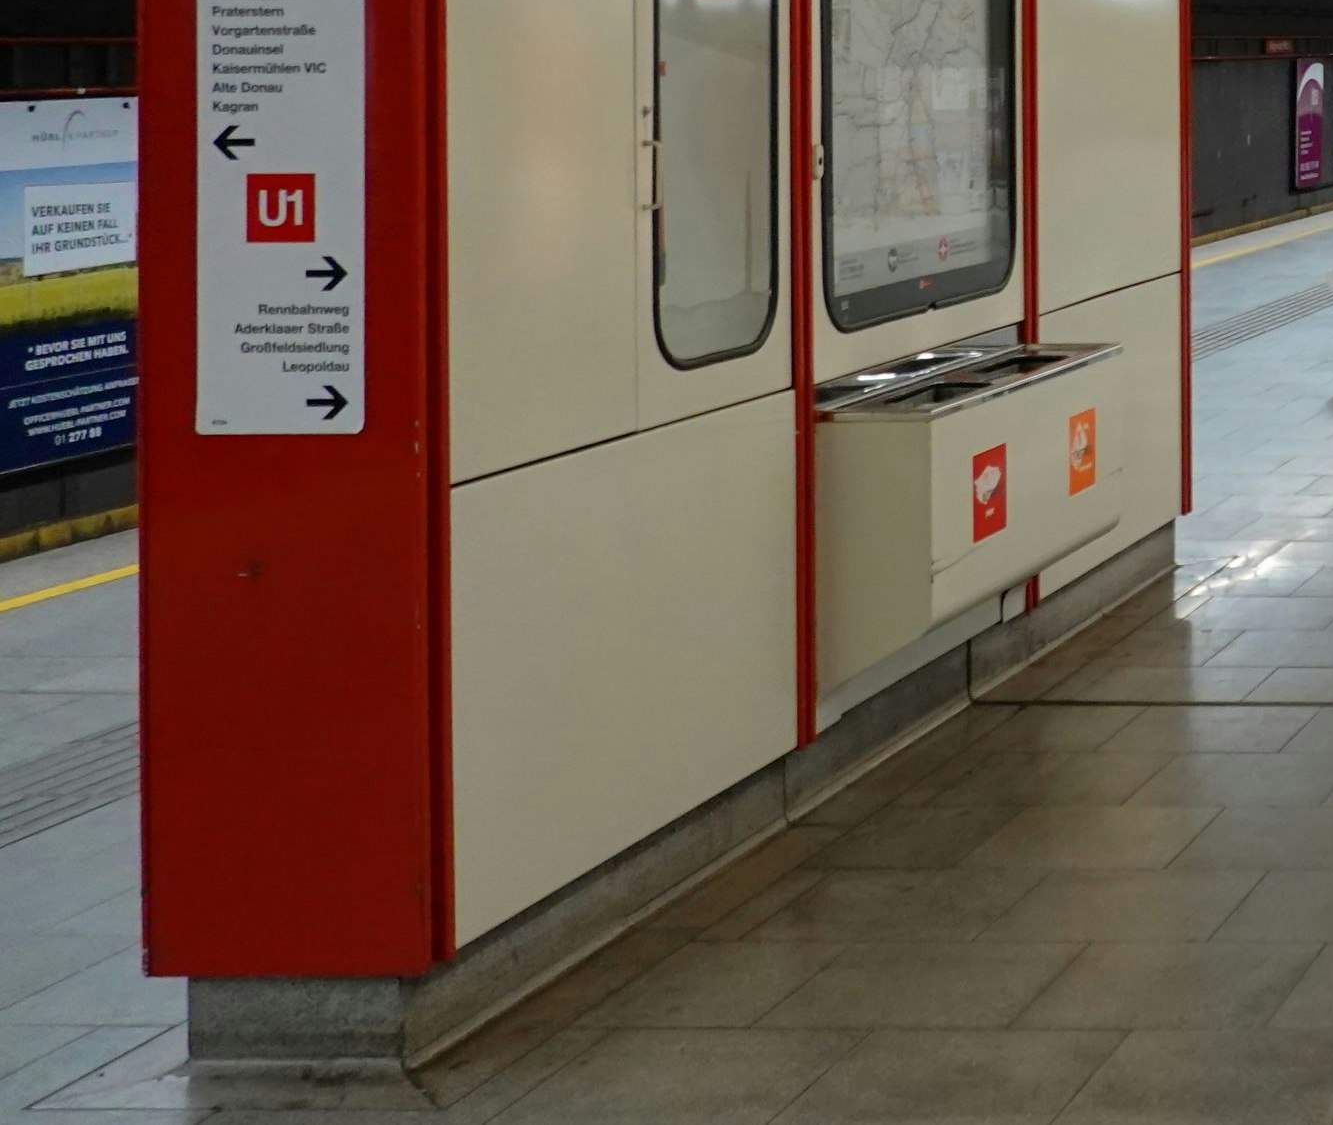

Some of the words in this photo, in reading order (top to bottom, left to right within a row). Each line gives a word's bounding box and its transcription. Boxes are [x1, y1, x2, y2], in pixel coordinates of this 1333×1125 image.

[211, 5, 285, 19] Praterstern
[211, 24, 317, 39] Vorgartenstraße
[211, 42, 284, 56] Donauinsel
[211, 61, 302, 75] Kaisermühlen
[304, 61, 328, 75] VIC
[211, 80, 238, 94] Alte
[240, 80, 284, 94] Donau
[211, 100, 260, 115] Kagran
[31, 203, 95, 218] VERKAUFEN
[97, 201, 112, 214] SIE
[257, 187, 305, 228] U1
[31, 223, 55, 237] AUF
[57, 220, 95, 234] KEINEN
[97, 218, 118, 230] FALL
[31, 241, 51, 255] IHR
[257, 303, 351, 318] Rennbahnweg
[234, 322, 305, 336] Aderklaaer
[307, 321, 351, 336] Straße
[35, 340, 70, 356] BEVOR
[87, 335, 106, 347] MIT
[107, 331, 127, 344] UNS
[240, 340, 351, 356] Großfeldsiedlung
[282, 360, 351, 375] Leopoldau
[68, 430, 87, 443] 277
